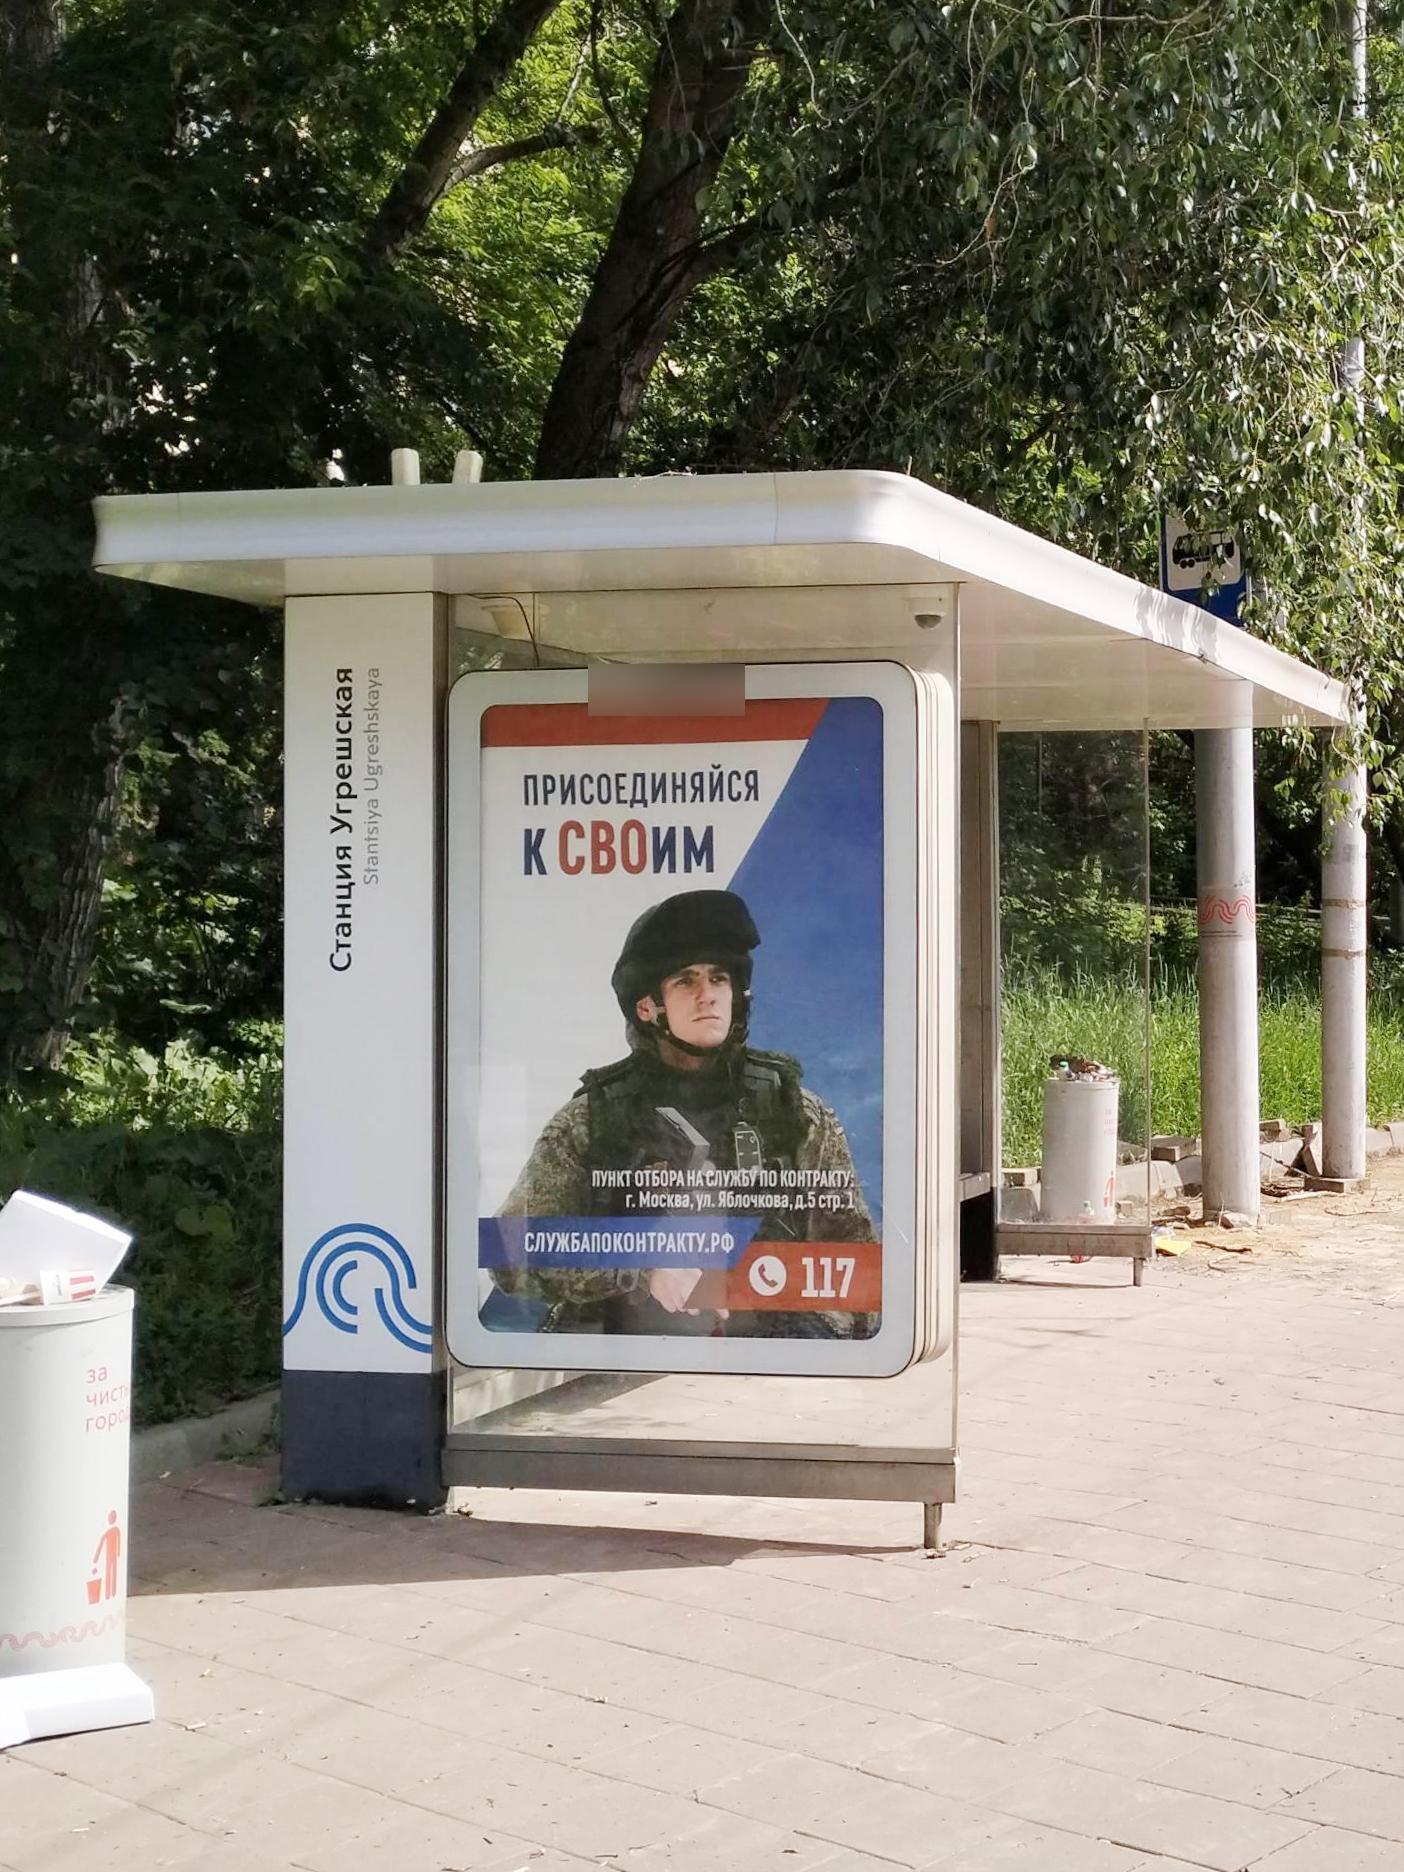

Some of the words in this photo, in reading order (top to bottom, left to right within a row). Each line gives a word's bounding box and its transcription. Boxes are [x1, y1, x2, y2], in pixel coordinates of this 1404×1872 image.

[329, 668, 358, 834] Угрешская
[363, 667, 384, 791] Ugreshskaya
[523, 764, 760, 808] ПРИСОЕДИНЯЙСЯ
[363, 799, 383, 885] Stantsiya
[523, 828, 548, 876] К
[329, 845, 356, 972] Станция
[592, 1170, 633, 1188] ПУНКТ
[635, 1170, 685, 1187] ОТБОРА
[687, 1170, 702, 1187] НА
[705, 1170, 756, 1188] СЛУЖБУ
[760, 1170, 777, 1187] ПО
[780, 1170, 854, 1187] КОНТРАКТУ:
[625, 1195, 636, 1208] г.
[638, 1192, 695, 1209] Москва,
[696, 1196, 715, 1212] ул.
[818, 1195, 845, 1211] стр.
[847, 1192, 855, 1208] 1
[524, 1232, 735, 1255] СЛУЖБАПОКОНТРАКТУ.РФ
[801, 1257, 855, 1298] 117
[86, 1366, 108, 1384] за
